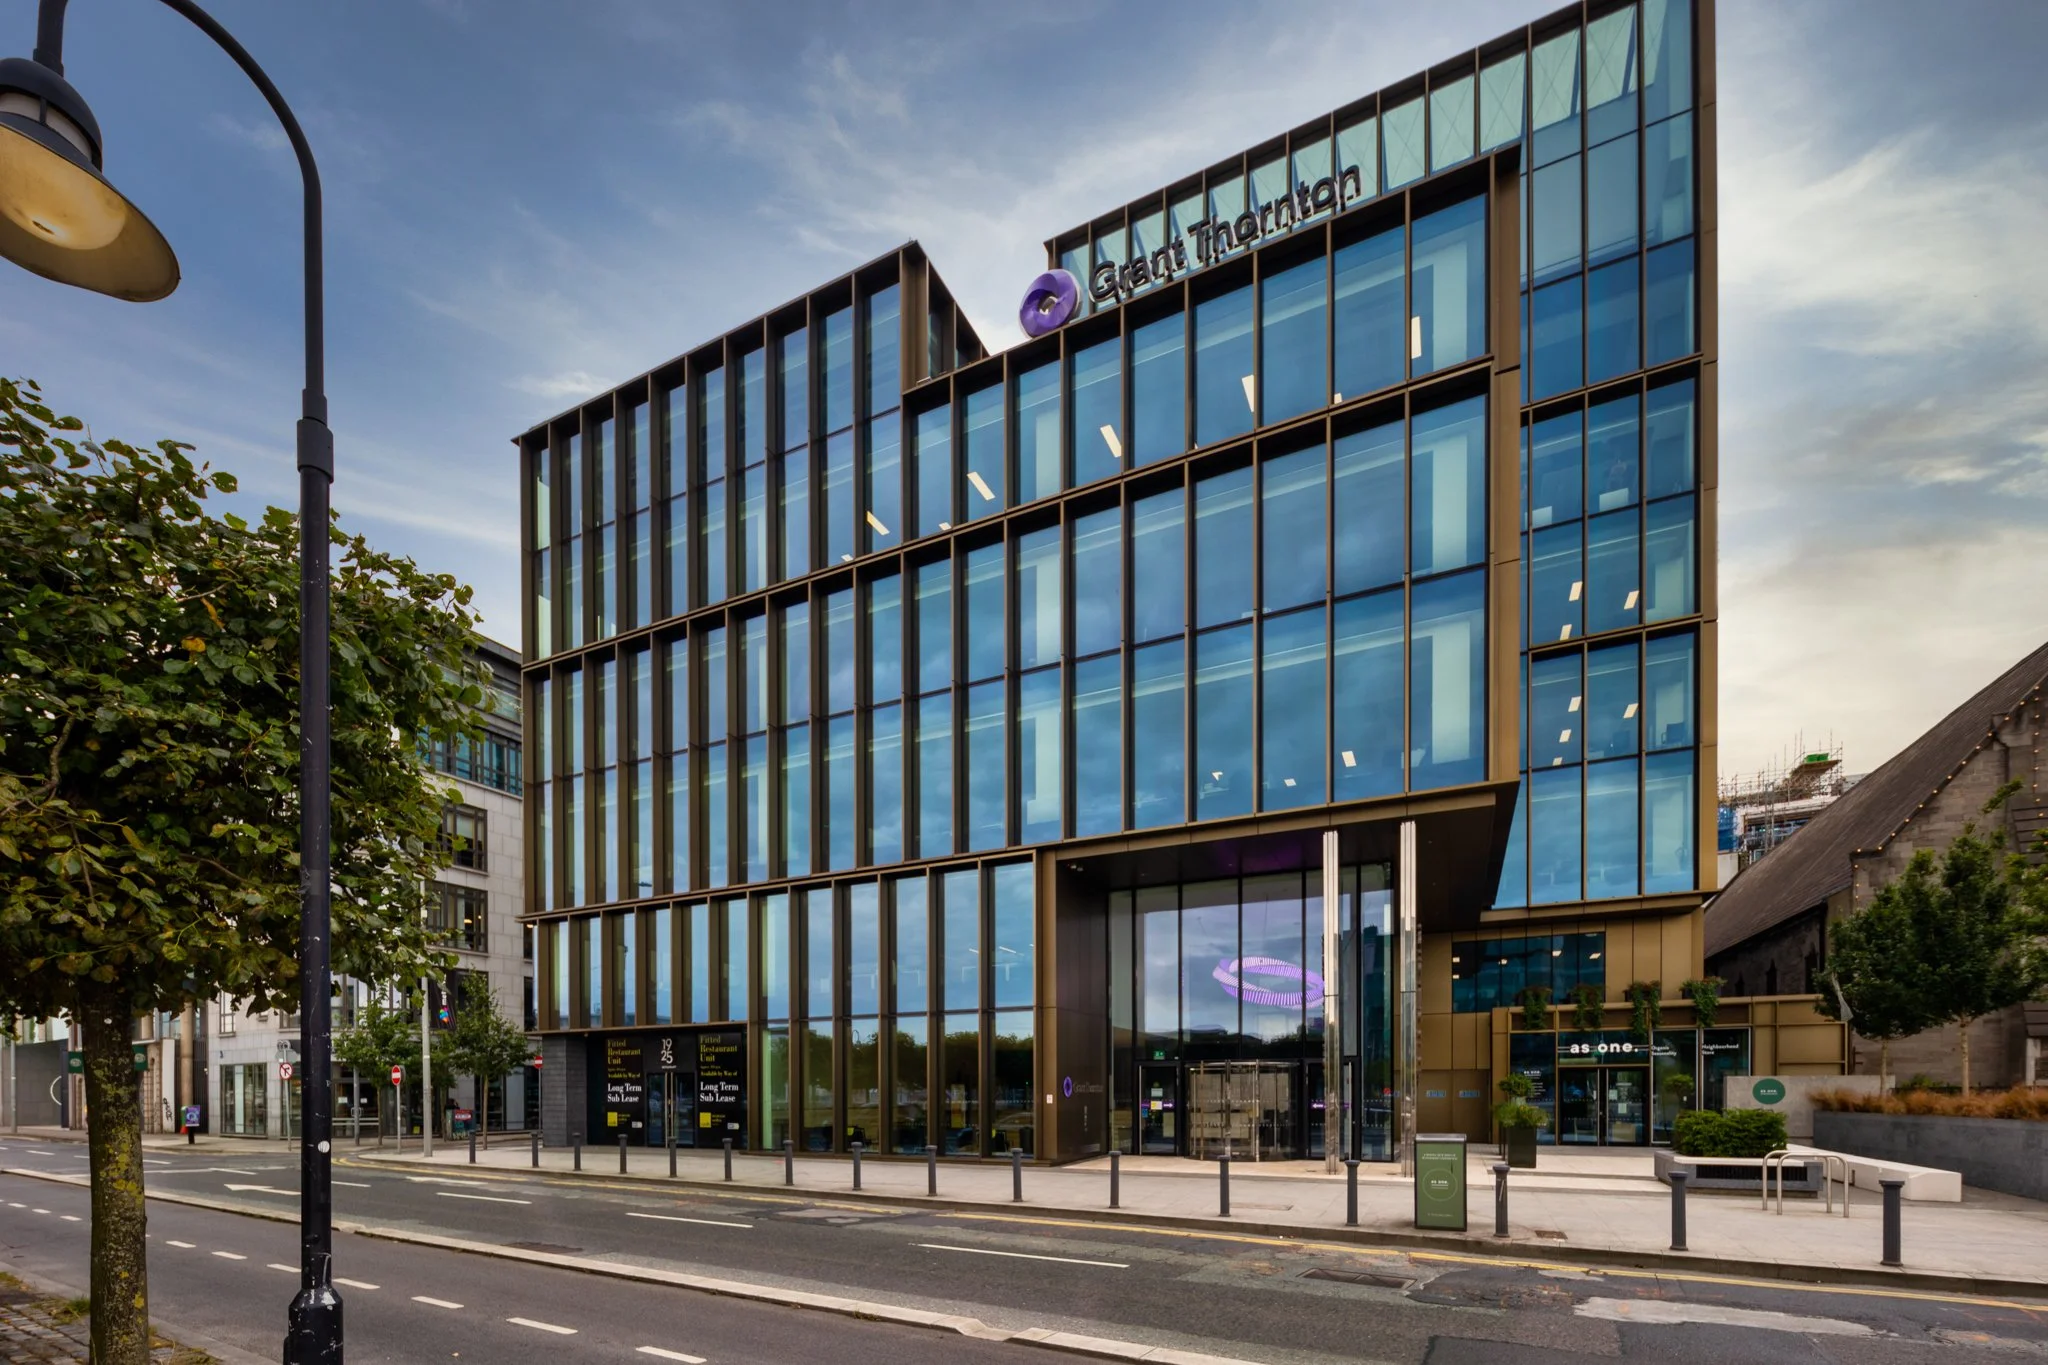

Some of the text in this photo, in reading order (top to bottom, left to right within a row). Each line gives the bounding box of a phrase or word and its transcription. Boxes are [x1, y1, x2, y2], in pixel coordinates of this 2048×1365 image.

[1090, 164, 1362, 303] Grant Thornton
[607, 1039, 627, 1047] Fitted
[700, 1035, 721, 1044] Fitted
[662, 1038, 673, 1051] 19
[700, 1044, 738, 1053] Restaurant
[1570, 1041, 1639, 1054] as one.
[607, 1048, 641, 1056] Restaurant
[607, 1056, 622, 1065] Unit
[661, 1050, 673, 1064] 25
[700, 1053, 715, 1062] Unit
[607, 1082, 642, 1094] Long Term
[700, 1081, 739, 1094] Long Term
[607, 1093, 639, 1102] Sub Lease
[700, 1092, 736, 1102] Sub Lease
